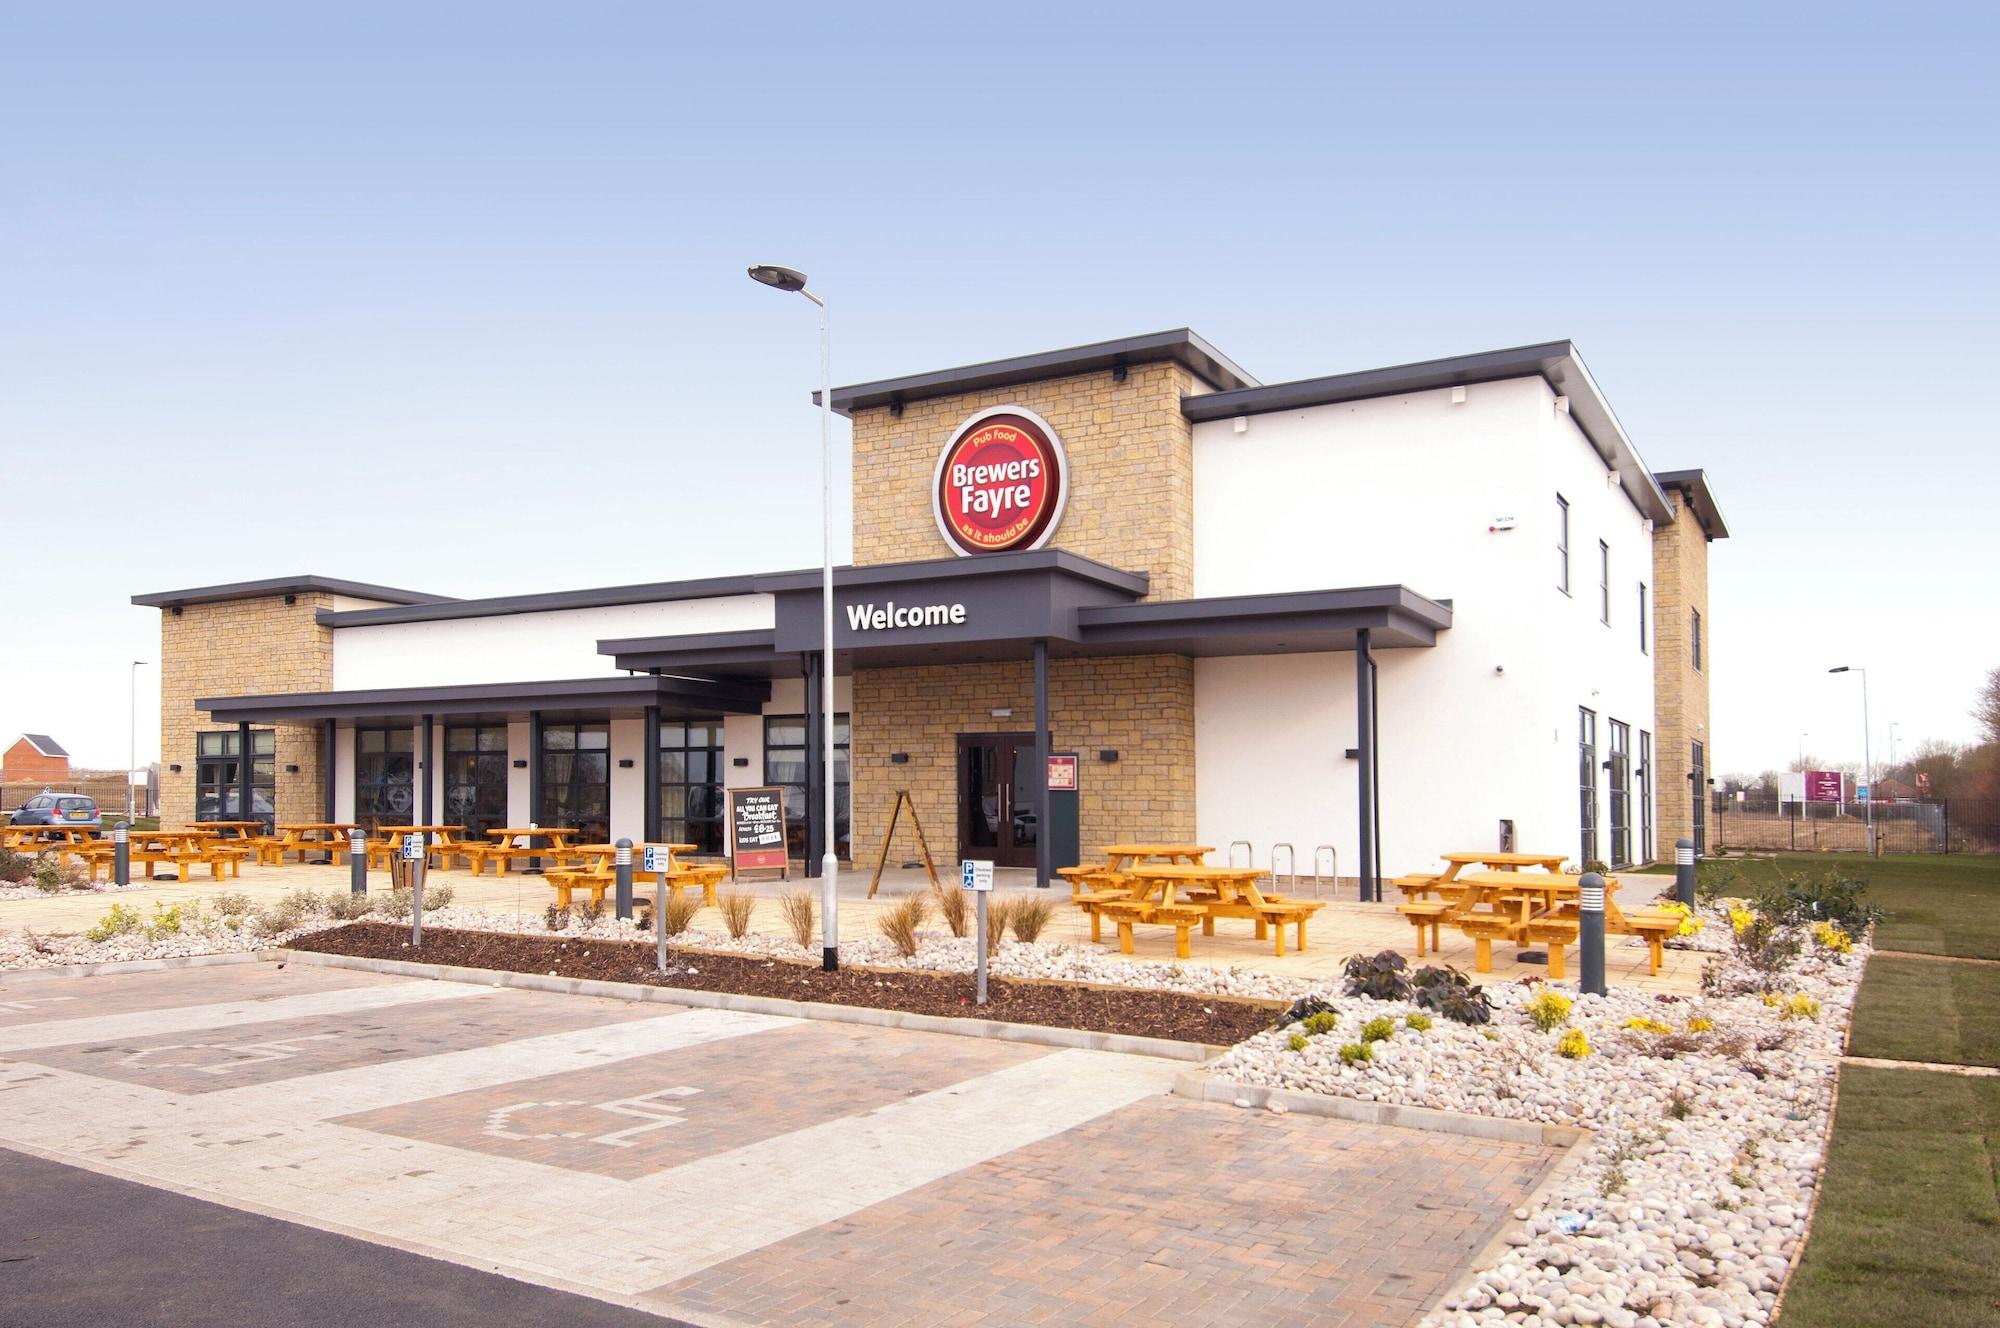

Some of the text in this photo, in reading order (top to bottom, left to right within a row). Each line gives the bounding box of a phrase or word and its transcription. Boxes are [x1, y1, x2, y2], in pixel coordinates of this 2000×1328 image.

[973, 429, 1018, 448] Pub food
[953, 458, 1040, 487] Brewers
[961, 484, 1031, 518] Fayre
[962, 517, 1030, 543] as it should be
[846, 601, 966, 631] Welcome
[742, 811, 778, 821] Breakfast
[966, 862, 972, 874] P
